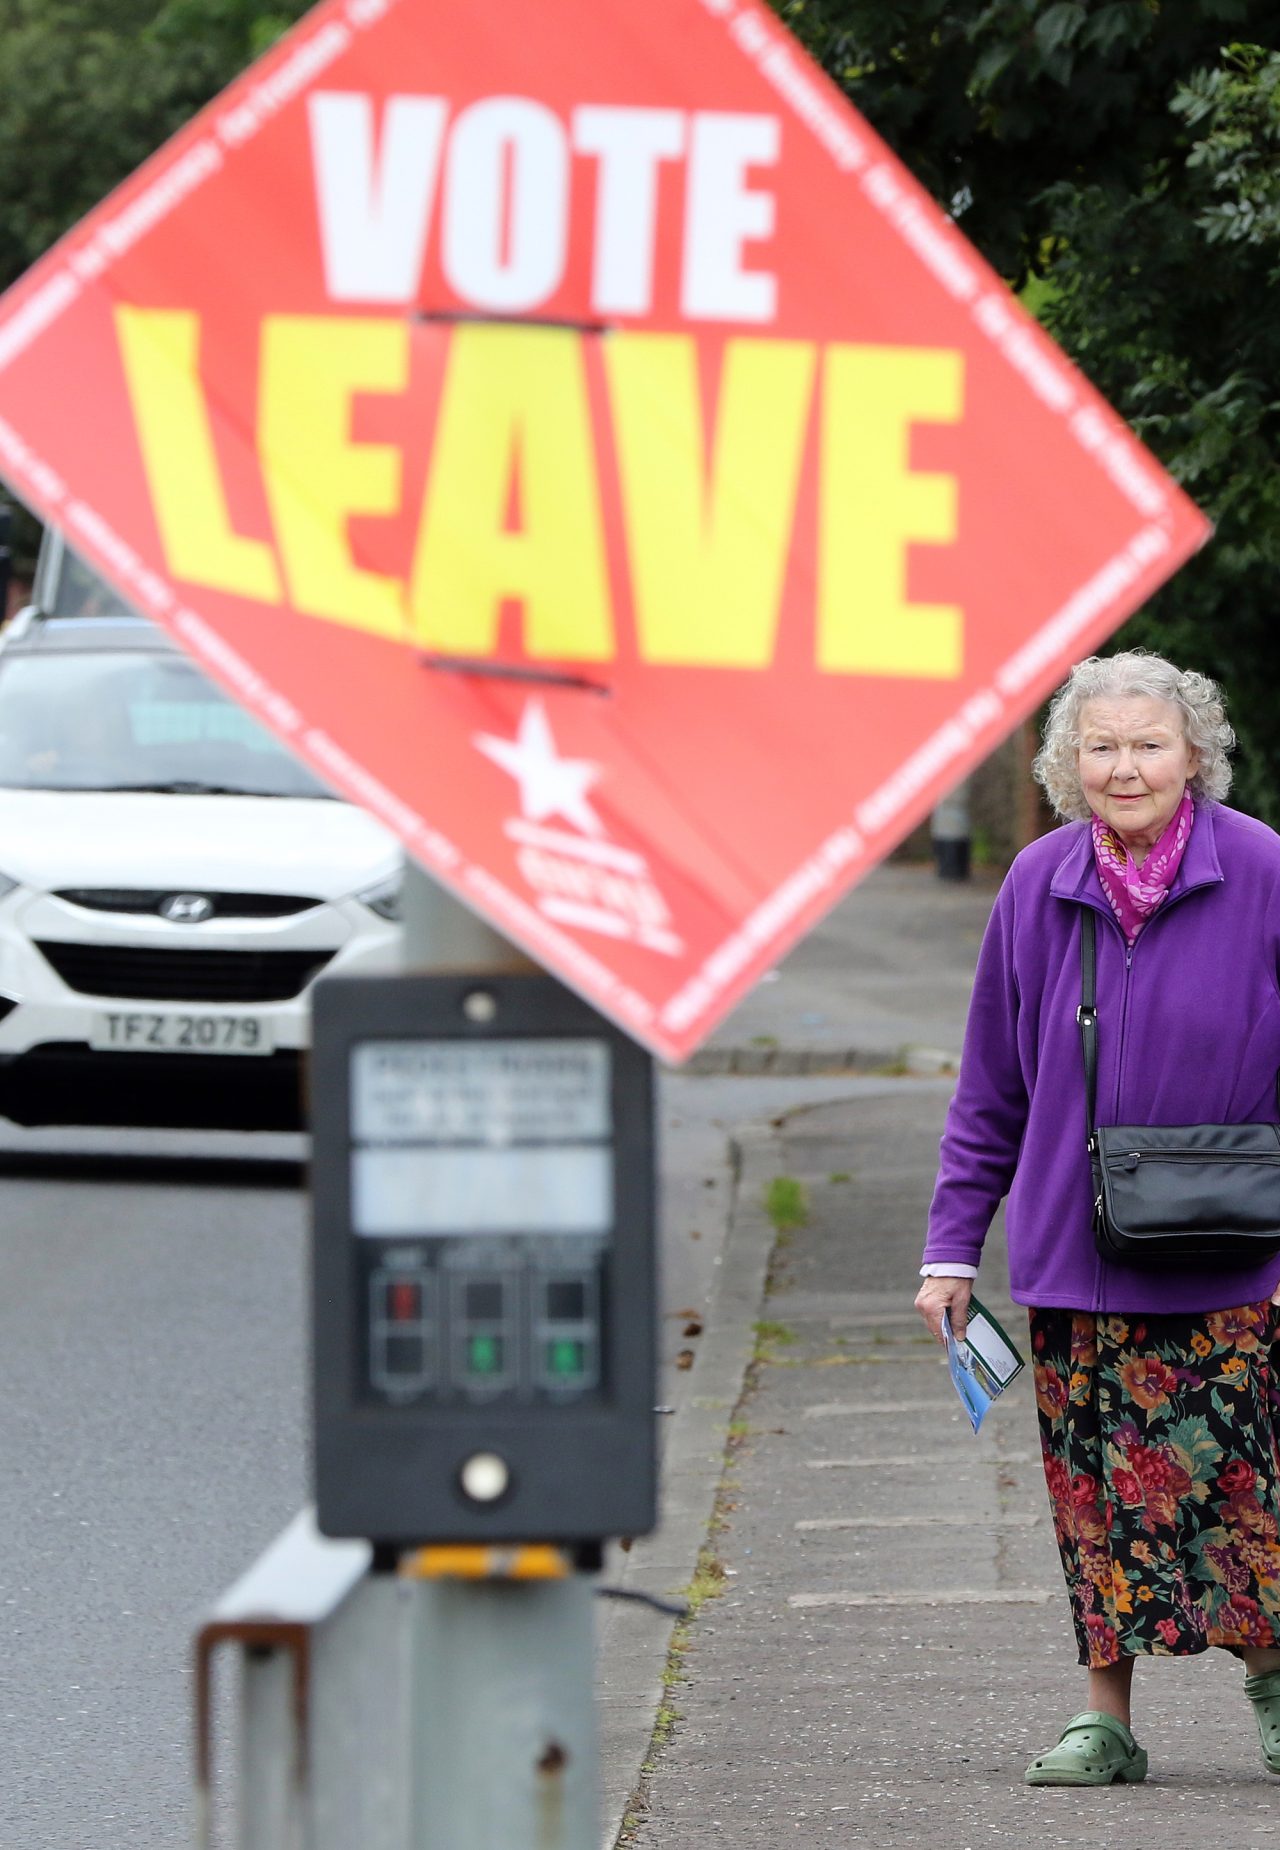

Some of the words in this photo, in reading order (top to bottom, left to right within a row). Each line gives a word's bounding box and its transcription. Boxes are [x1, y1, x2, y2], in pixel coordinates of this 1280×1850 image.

[308, 91, 780, 324] VOTE
[114, 304, 966, 681] LEAVE
[106, 1013, 163, 1042] TFZ
[175, 1016, 260, 1047] 2079
